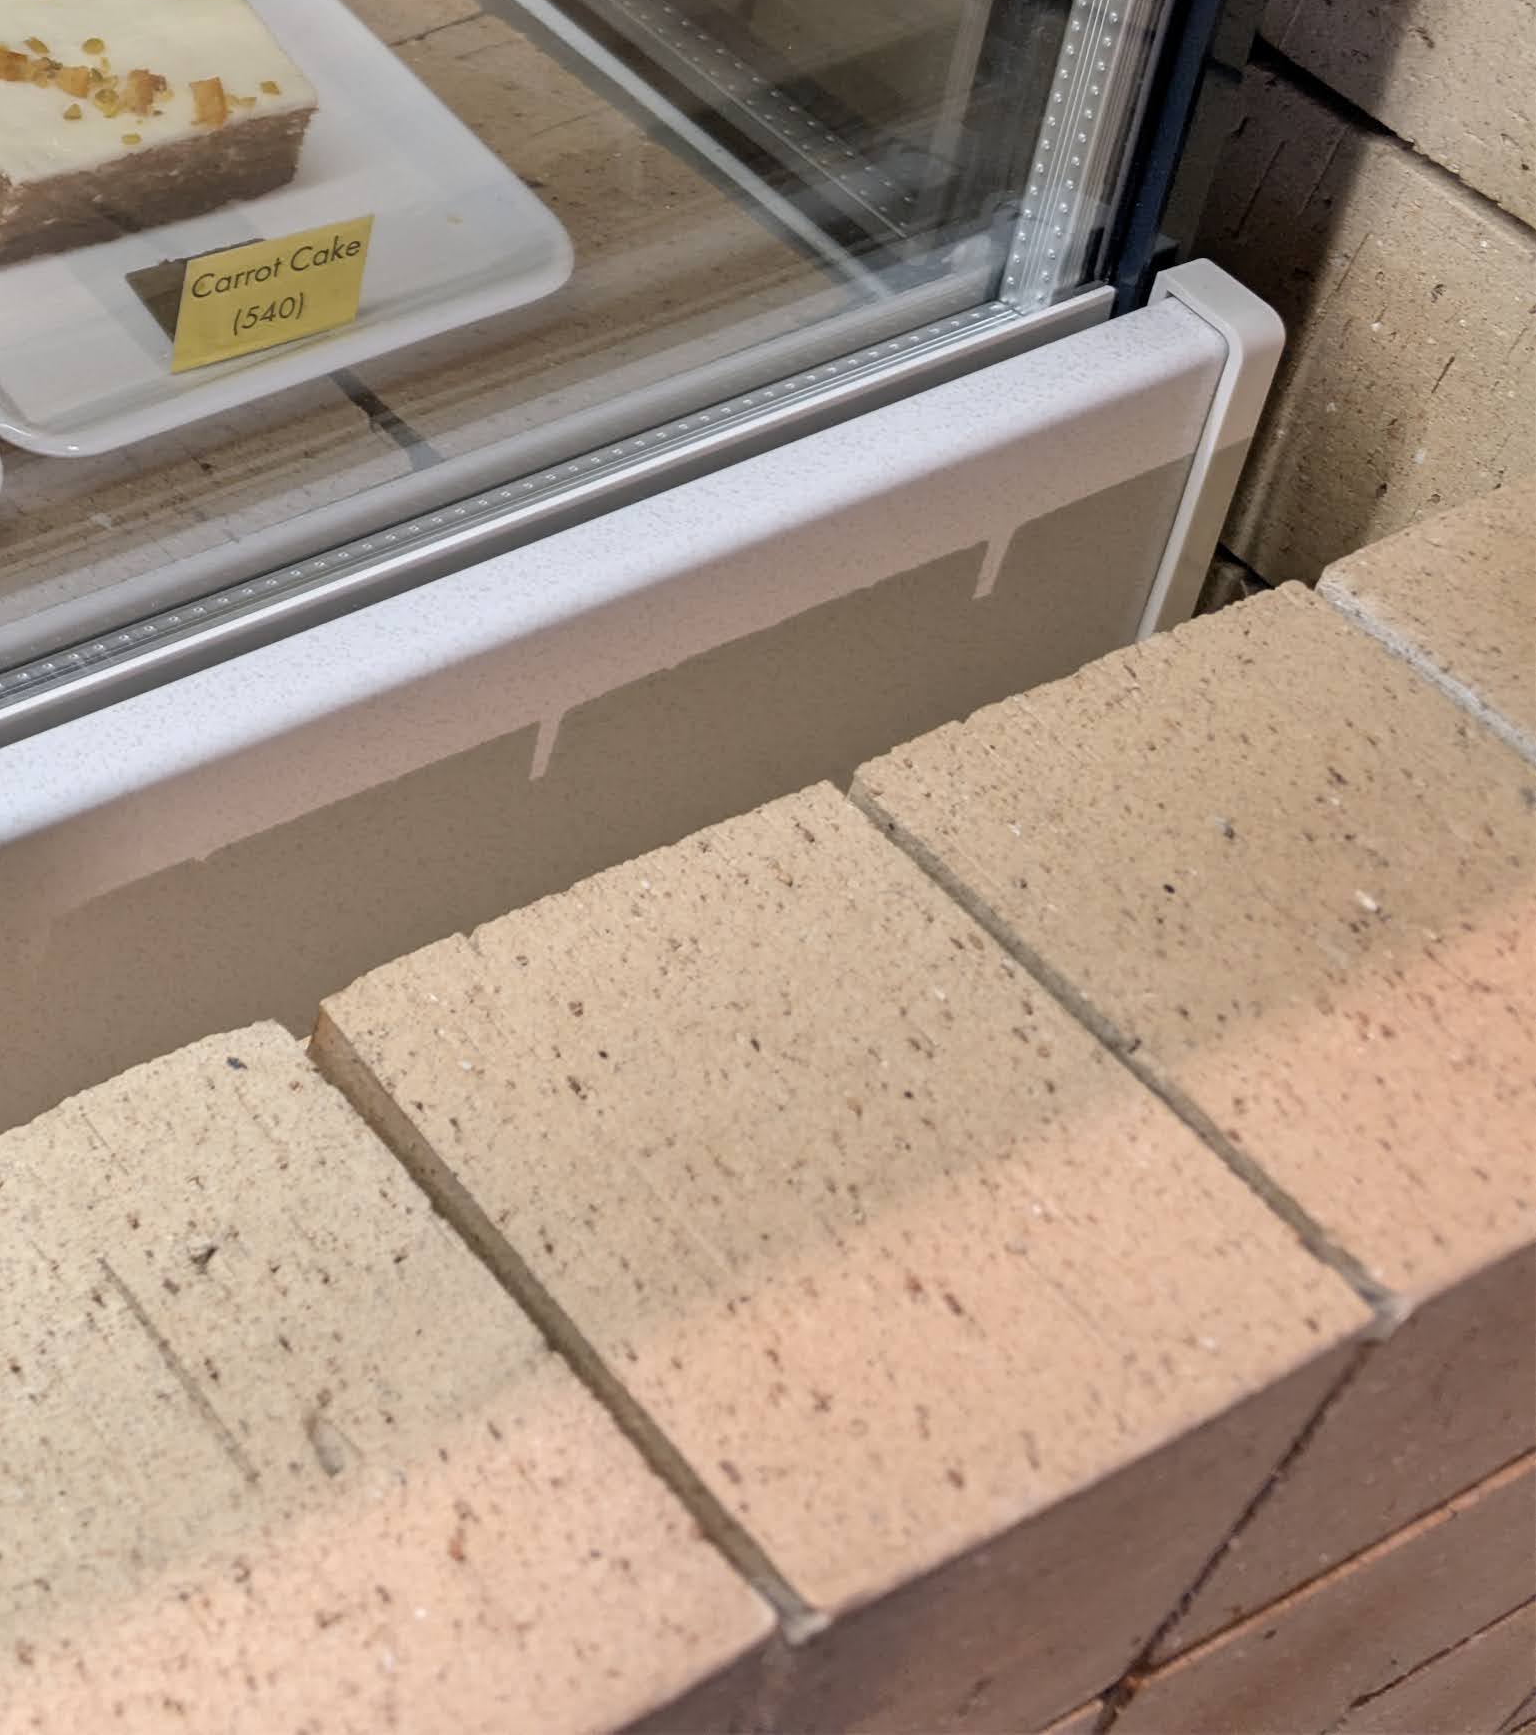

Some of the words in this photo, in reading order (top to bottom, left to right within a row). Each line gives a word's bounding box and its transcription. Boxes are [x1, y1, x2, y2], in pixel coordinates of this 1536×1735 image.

[191, 256, 281, 298] Carrot
[290, 235, 361, 272] Cake
[233, 292, 304, 336] (540)
